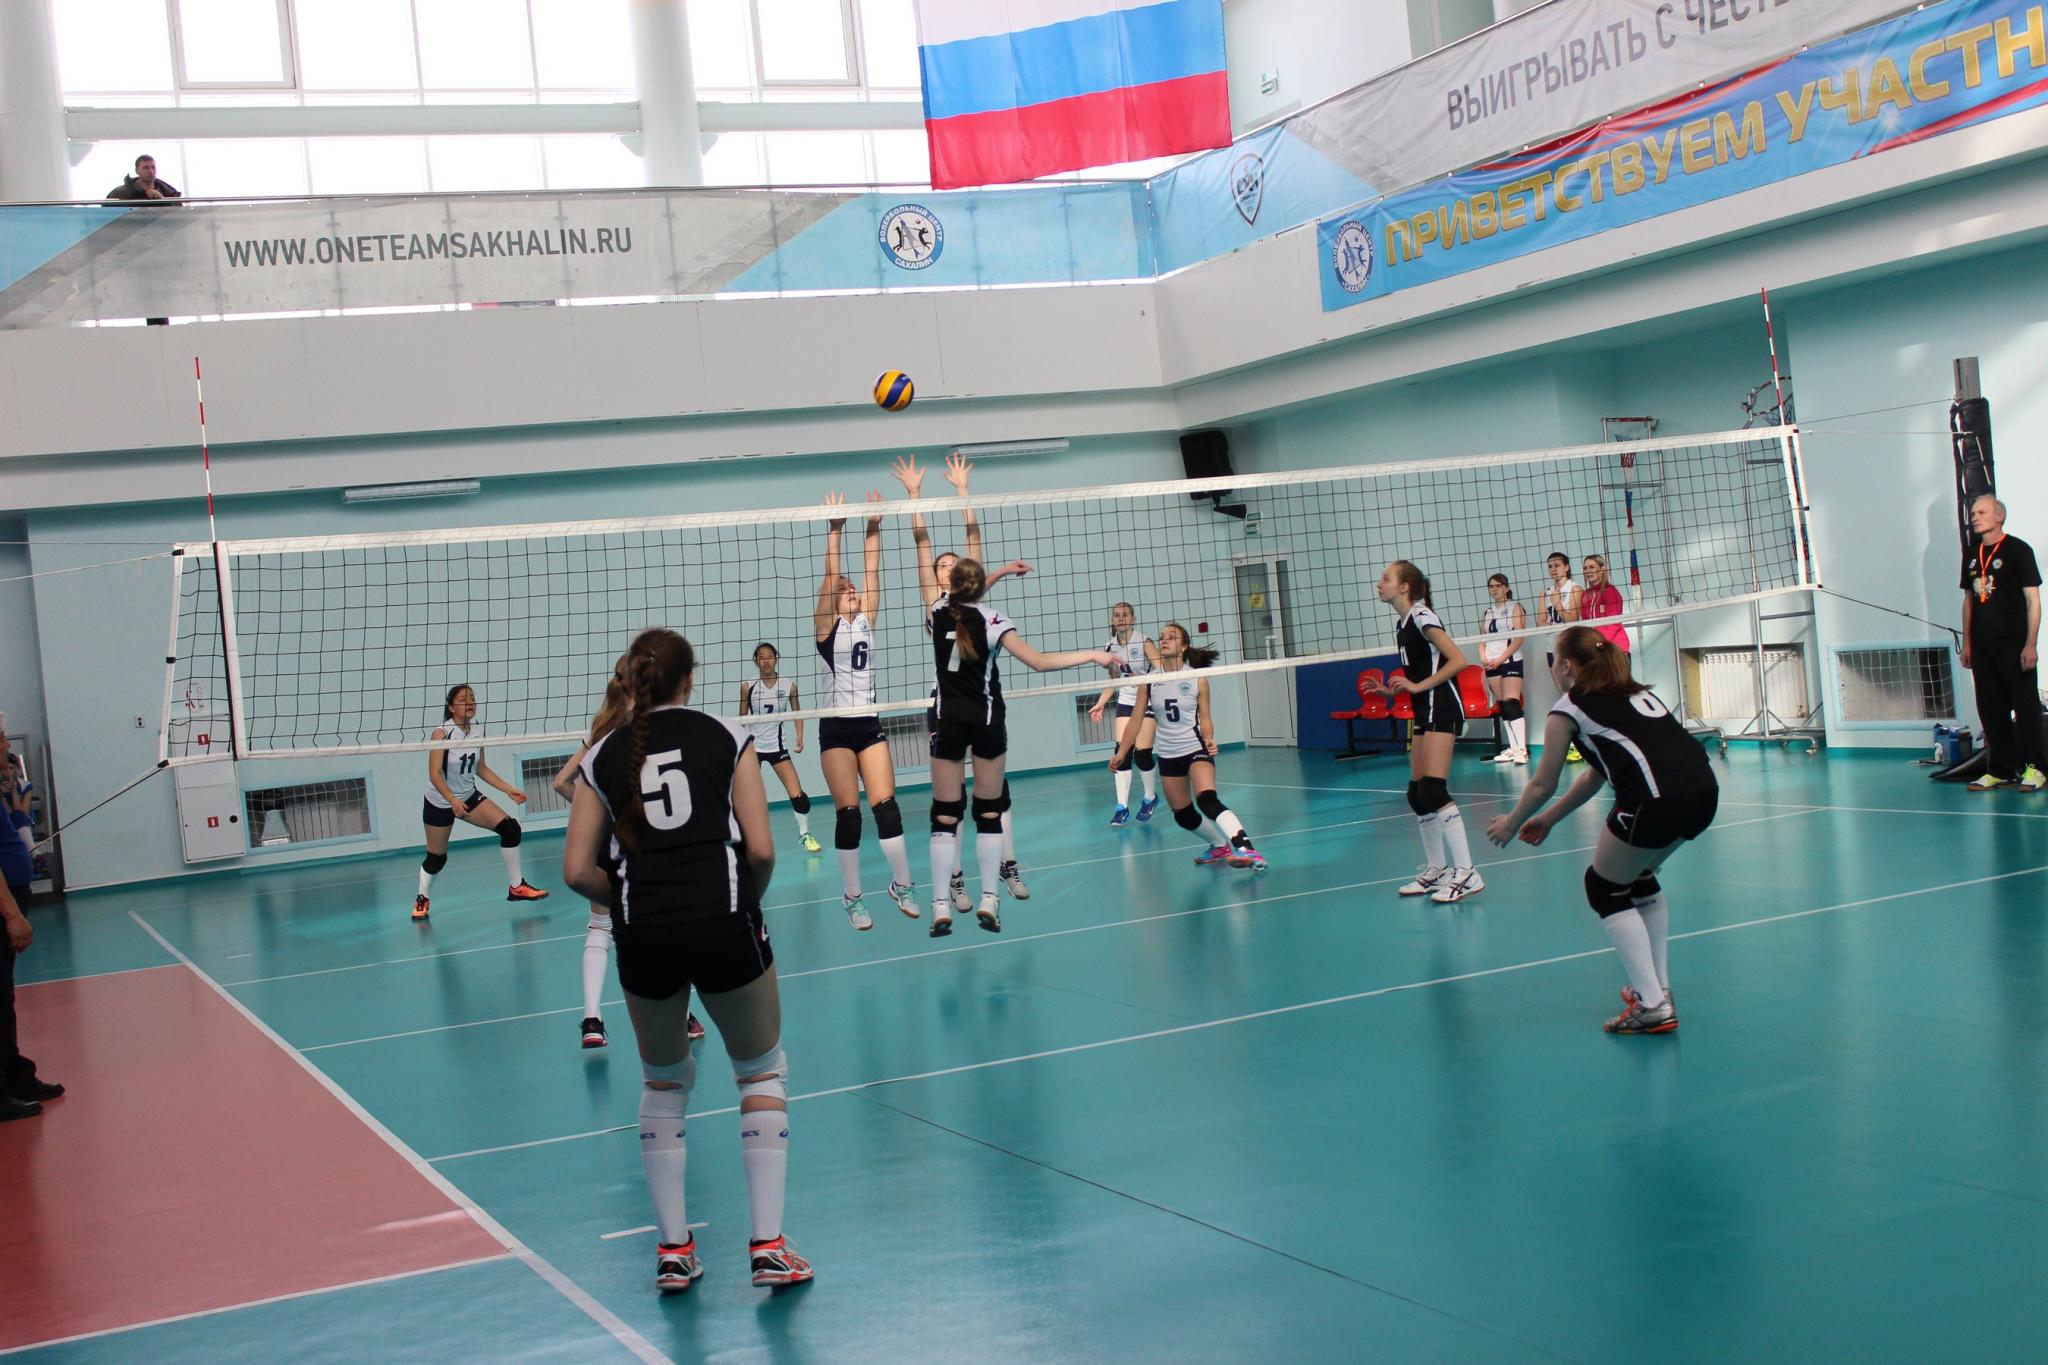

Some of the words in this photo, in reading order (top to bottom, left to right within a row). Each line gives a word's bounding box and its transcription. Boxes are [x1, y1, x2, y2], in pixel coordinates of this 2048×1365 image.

[1447, 16, 1647, 130] ВЫИГРЫВАТЬ
[1655, 4, 1676, 49] С
[1384, 101, 1767, 267] ПРИВЕТСТВУЕМ
[1775, 5, 2047, 144] УЧАСТН
[880, 205, 928, 243] ВОЛЕЙБОЛЬНЫЙ
[928, 215, 943, 241] ЦЕНТР
[224, 227, 633, 268] WWW.ONETEAMSAKHALIN.RU
[894, 257, 934, 269] САХАЛИН
[851, 640, 868, 671] 6
[945, 630, 961, 672] 7
[1164, 699, 1180, 723] 5
[459, 752, 476, 775] 11
[640, 748, 693, 831] 5
